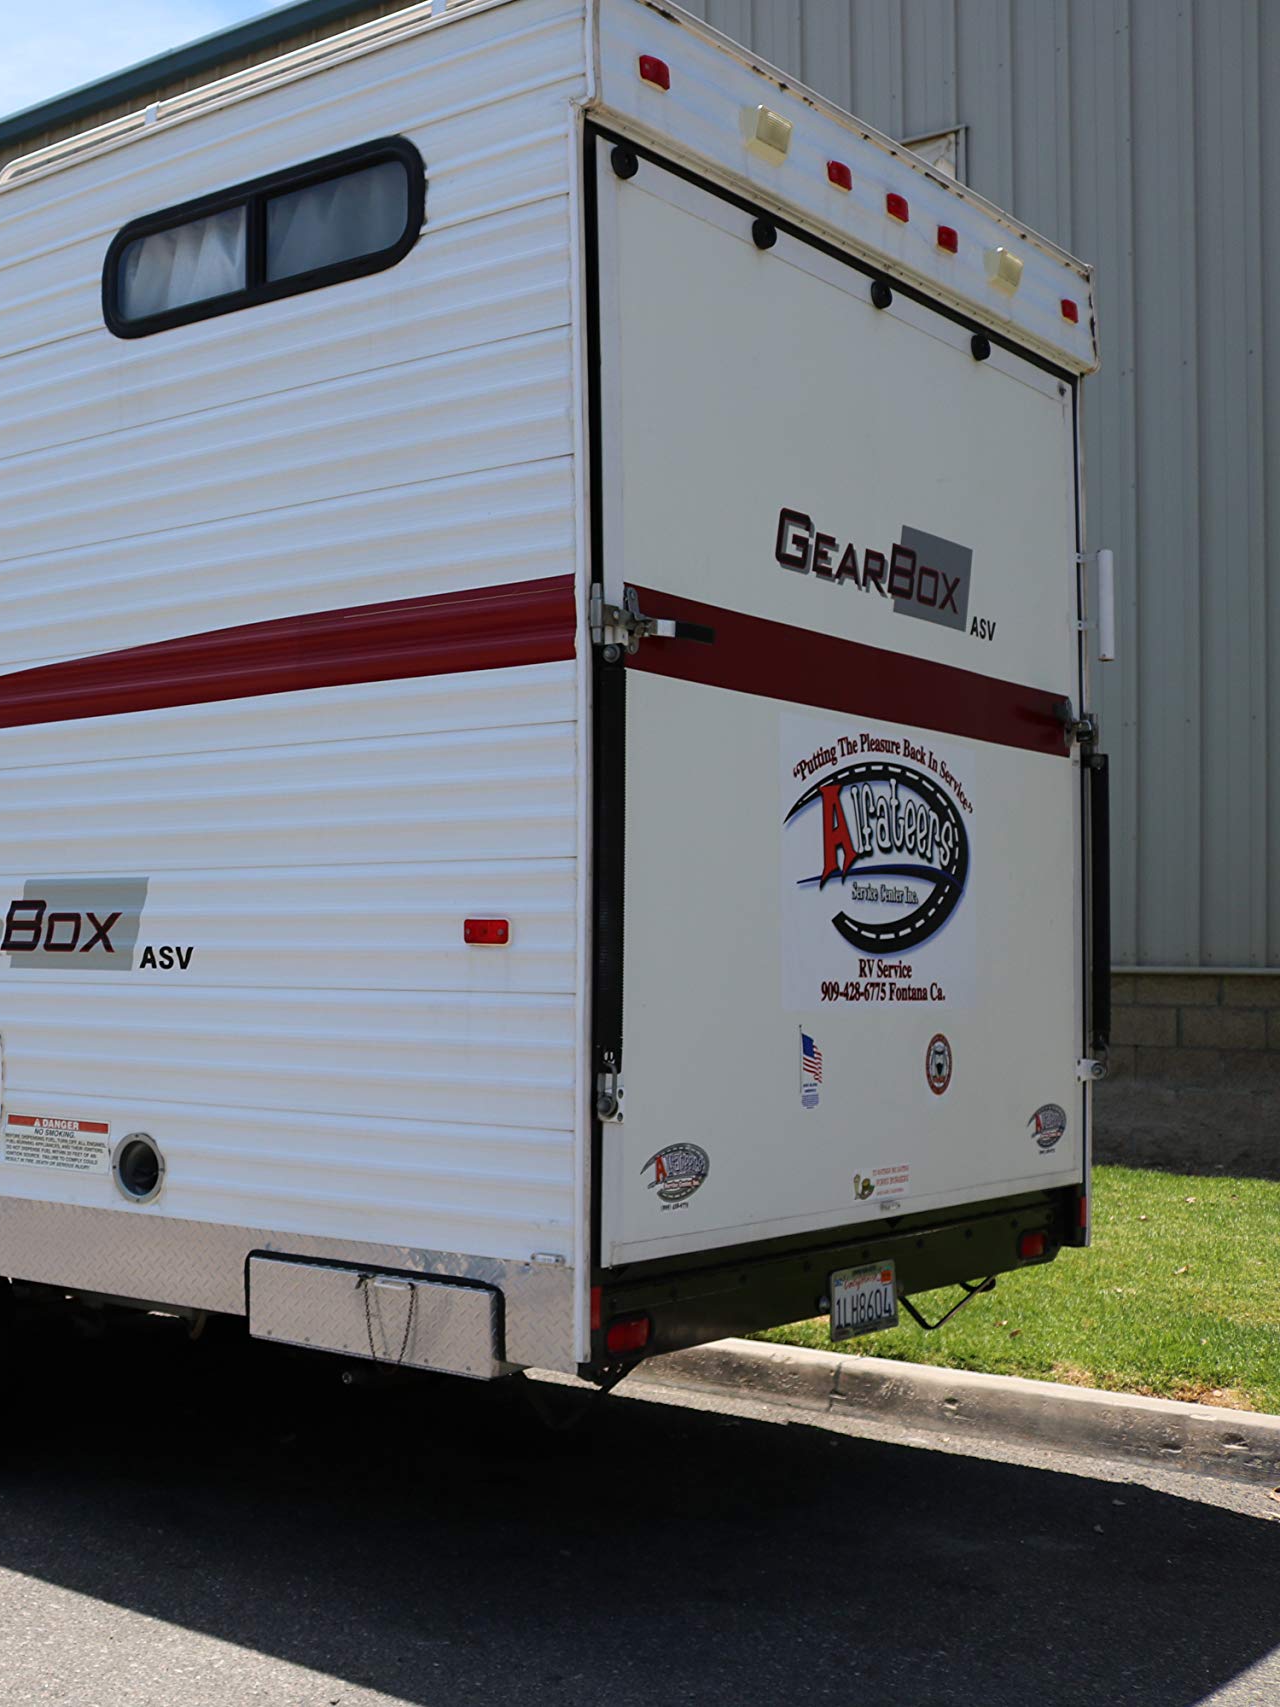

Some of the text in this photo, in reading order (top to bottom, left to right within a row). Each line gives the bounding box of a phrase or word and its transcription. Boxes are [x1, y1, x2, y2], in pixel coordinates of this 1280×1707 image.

[970, 616, 996, 641] ASV
[837, 736, 858, 757] The
[859, 733, 901, 755] Pleasure
[902, 738, 926, 765] Back
[928, 750, 938, 773] In
[819, 777, 954, 891] Alfateers
[851, 881, 919, 904] Service Center Inc.
[139, 946, 194, 970] ASV
[858, 958, 912, 979] RV Service
[821, 981, 946, 1002] 909-428-6775 Fontana Ca.
[34, 1128, 44, 1136] NO
[42, 1119, 79, 1130] DANGER
[836, 1287, 892, 1329] 1LH8604
